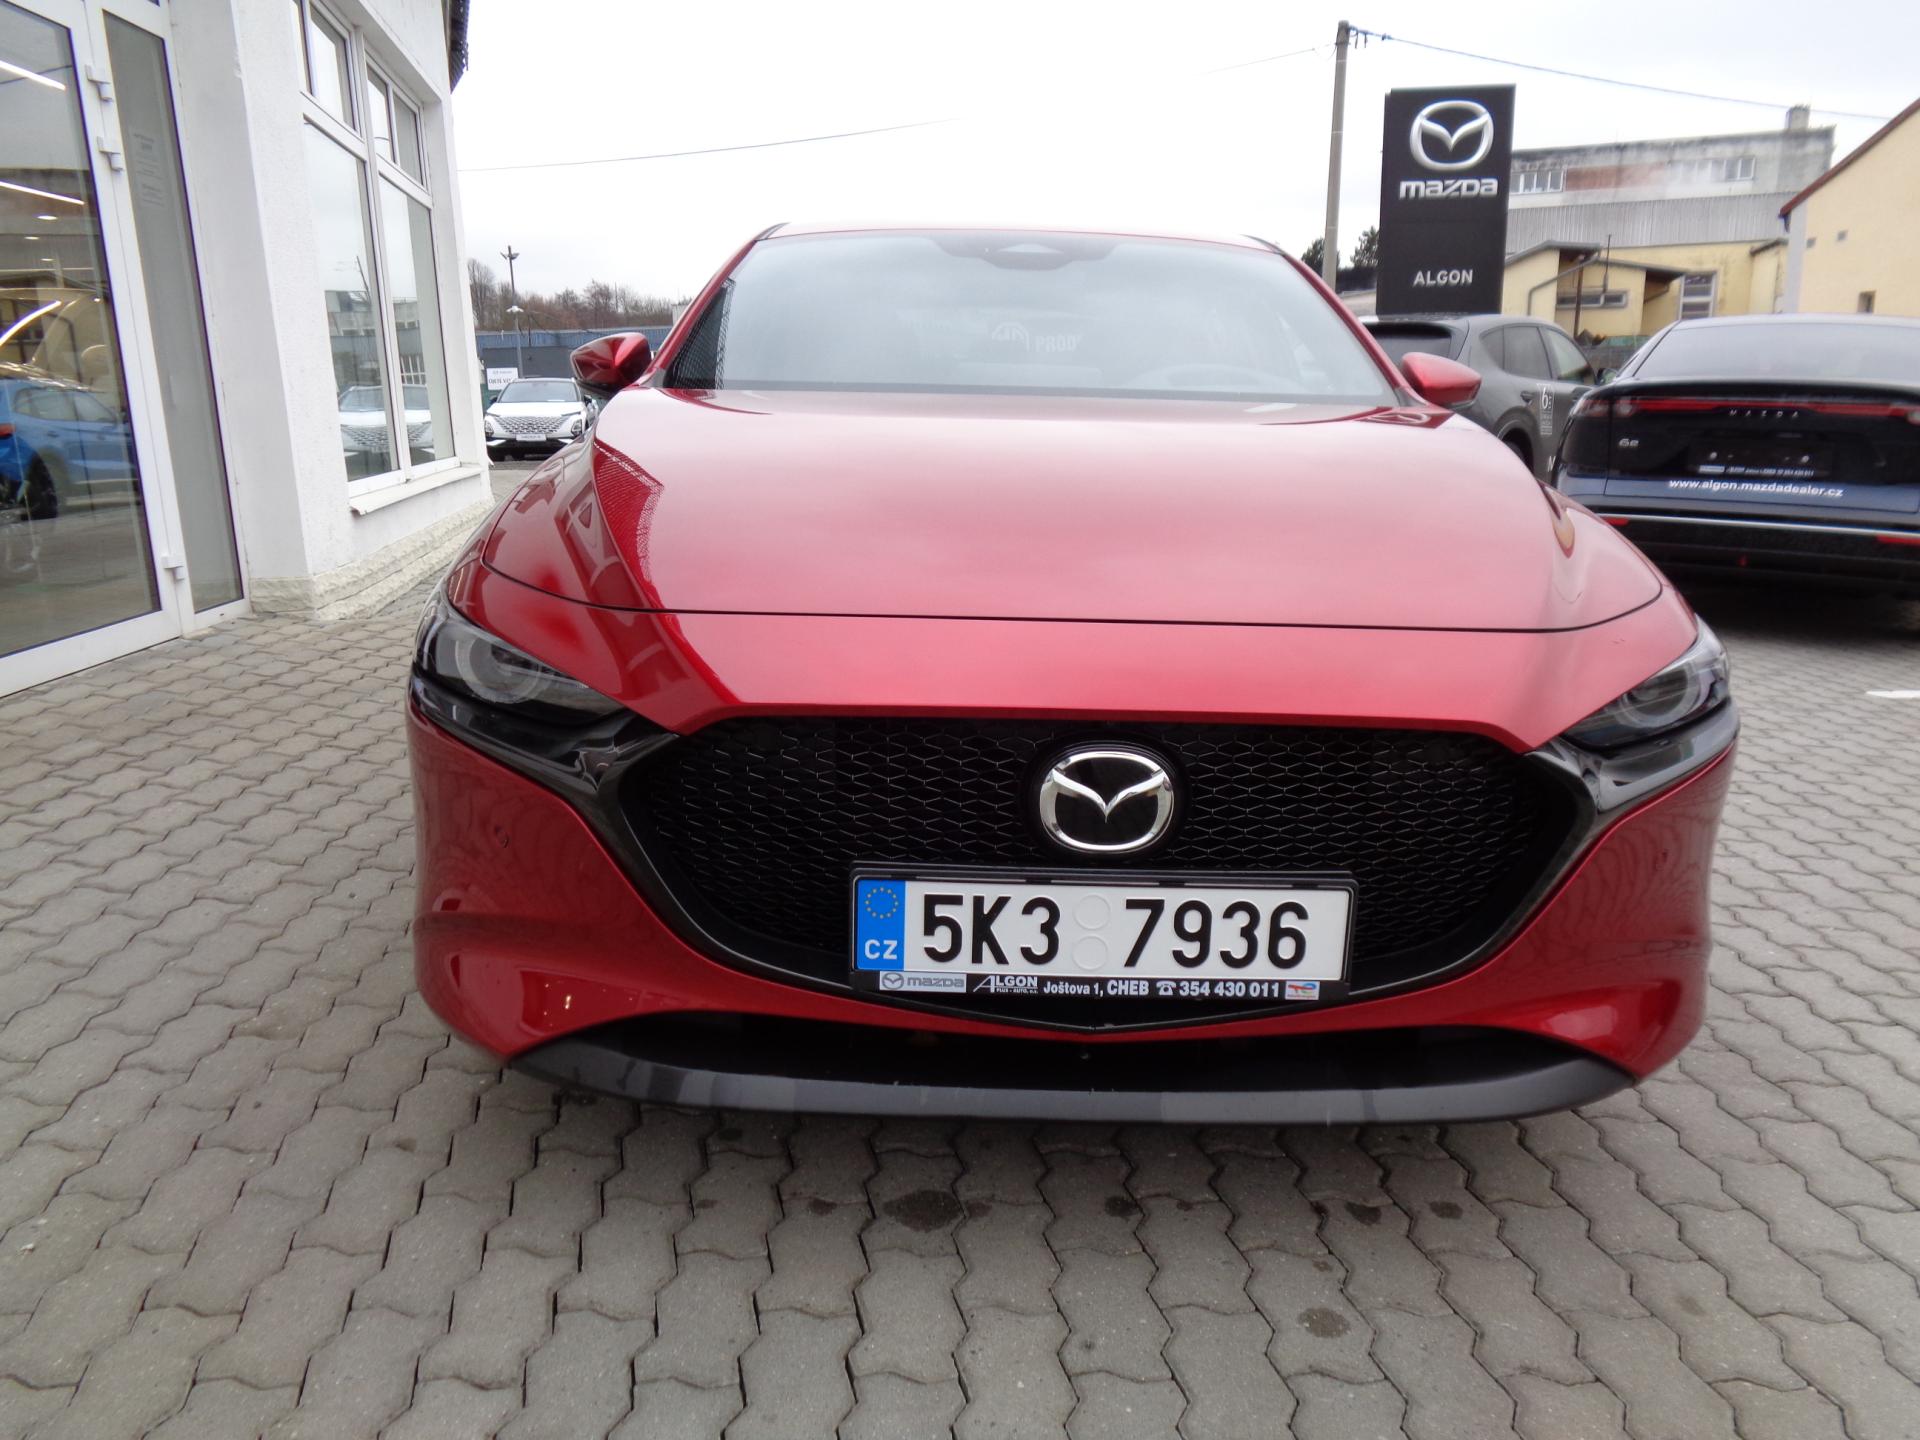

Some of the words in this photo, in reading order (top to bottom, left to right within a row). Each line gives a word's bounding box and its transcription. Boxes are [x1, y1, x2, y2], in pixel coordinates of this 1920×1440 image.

[1400, 178, 1499, 199] mazda
[1413, 269, 1474, 286] ALGON
[1729, 409, 1799, 418] MAZDA
[1669, 479, 1844, 498] www.algon.mazdadealer.cz
[922, 893, 1061, 966] 5K3
[1124, 898, 1310, 970] 7936
[864, 938, 898, 960] CZ
[906, 976, 965, 988] mazda
[973, 975, 1039, 993] ALGON
[1043, 981, 1091, 995] Joštova
[1094, 984, 1104, 998] 1,
[1107, 980, 1150, 996] CHEB
[1179, 981, 1211, 996] 354
[1214, 982, 1246, 997] 430
[1250, 982, 1279, 997] 011
